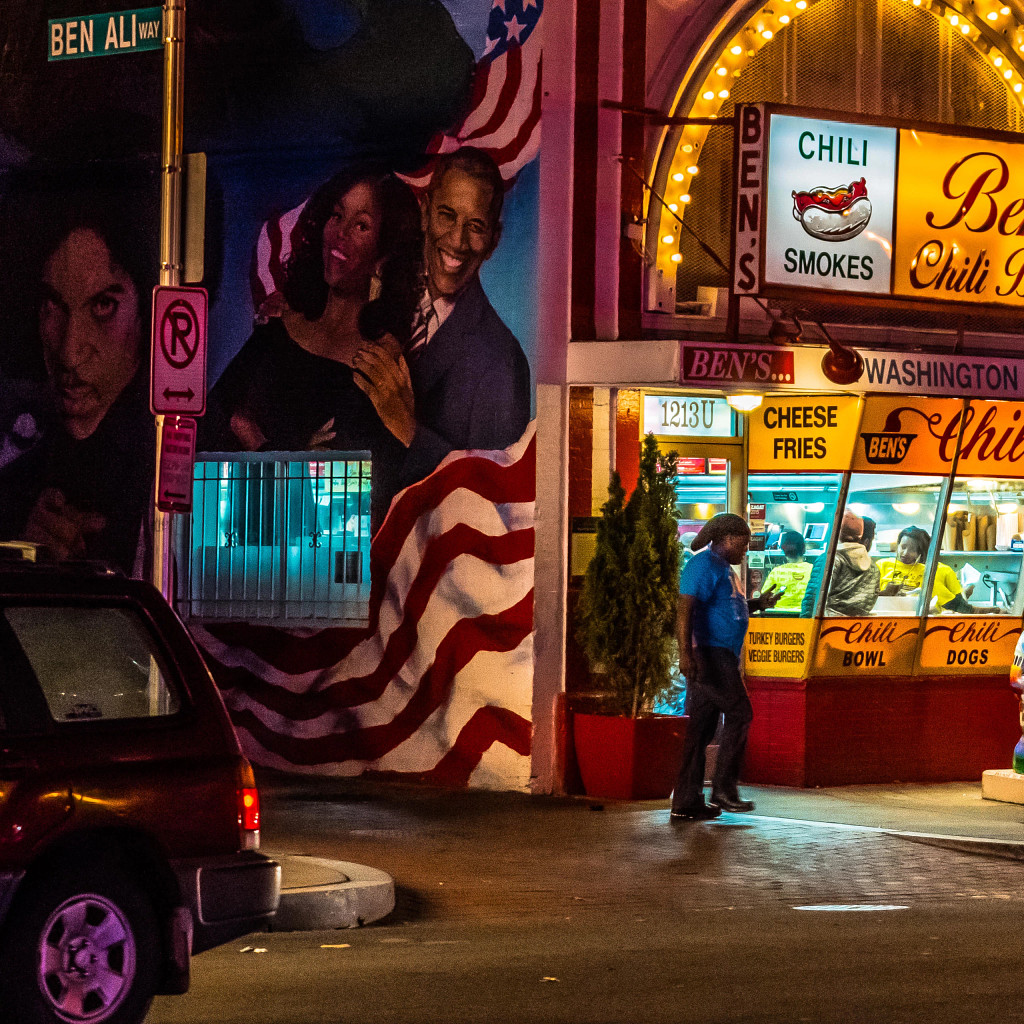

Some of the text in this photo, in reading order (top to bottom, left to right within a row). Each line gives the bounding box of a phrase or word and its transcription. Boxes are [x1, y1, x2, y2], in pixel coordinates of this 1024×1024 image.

[51, 14, 160, 56] BEN ALI WAY
[798, 131, 868, 167] CHILI
[737, 106, 761, 291] BEN'S
[784, 247, 874, 280] SMOKES
[909, 239, 990, 294] Chili
[865, 358, 1018, 391] WASHINGTON
[661, 399, 699, 429] 1213
[763, 405, 838, 429] CHEESE
[773, 436, 828, 460] FRIES
[869, 435, 908, 459] BEN'S
[748, 631, 805, 646] TURKEY BURGERS
[843, 622, 897, 644] Chili
[948, 621, 1001, 643] Chili
[748, 649, 805, 663] VEGGIE BURGERS
[842, 650, 886, 667] BOWL
[946, 648, 989, 665] DOGS
